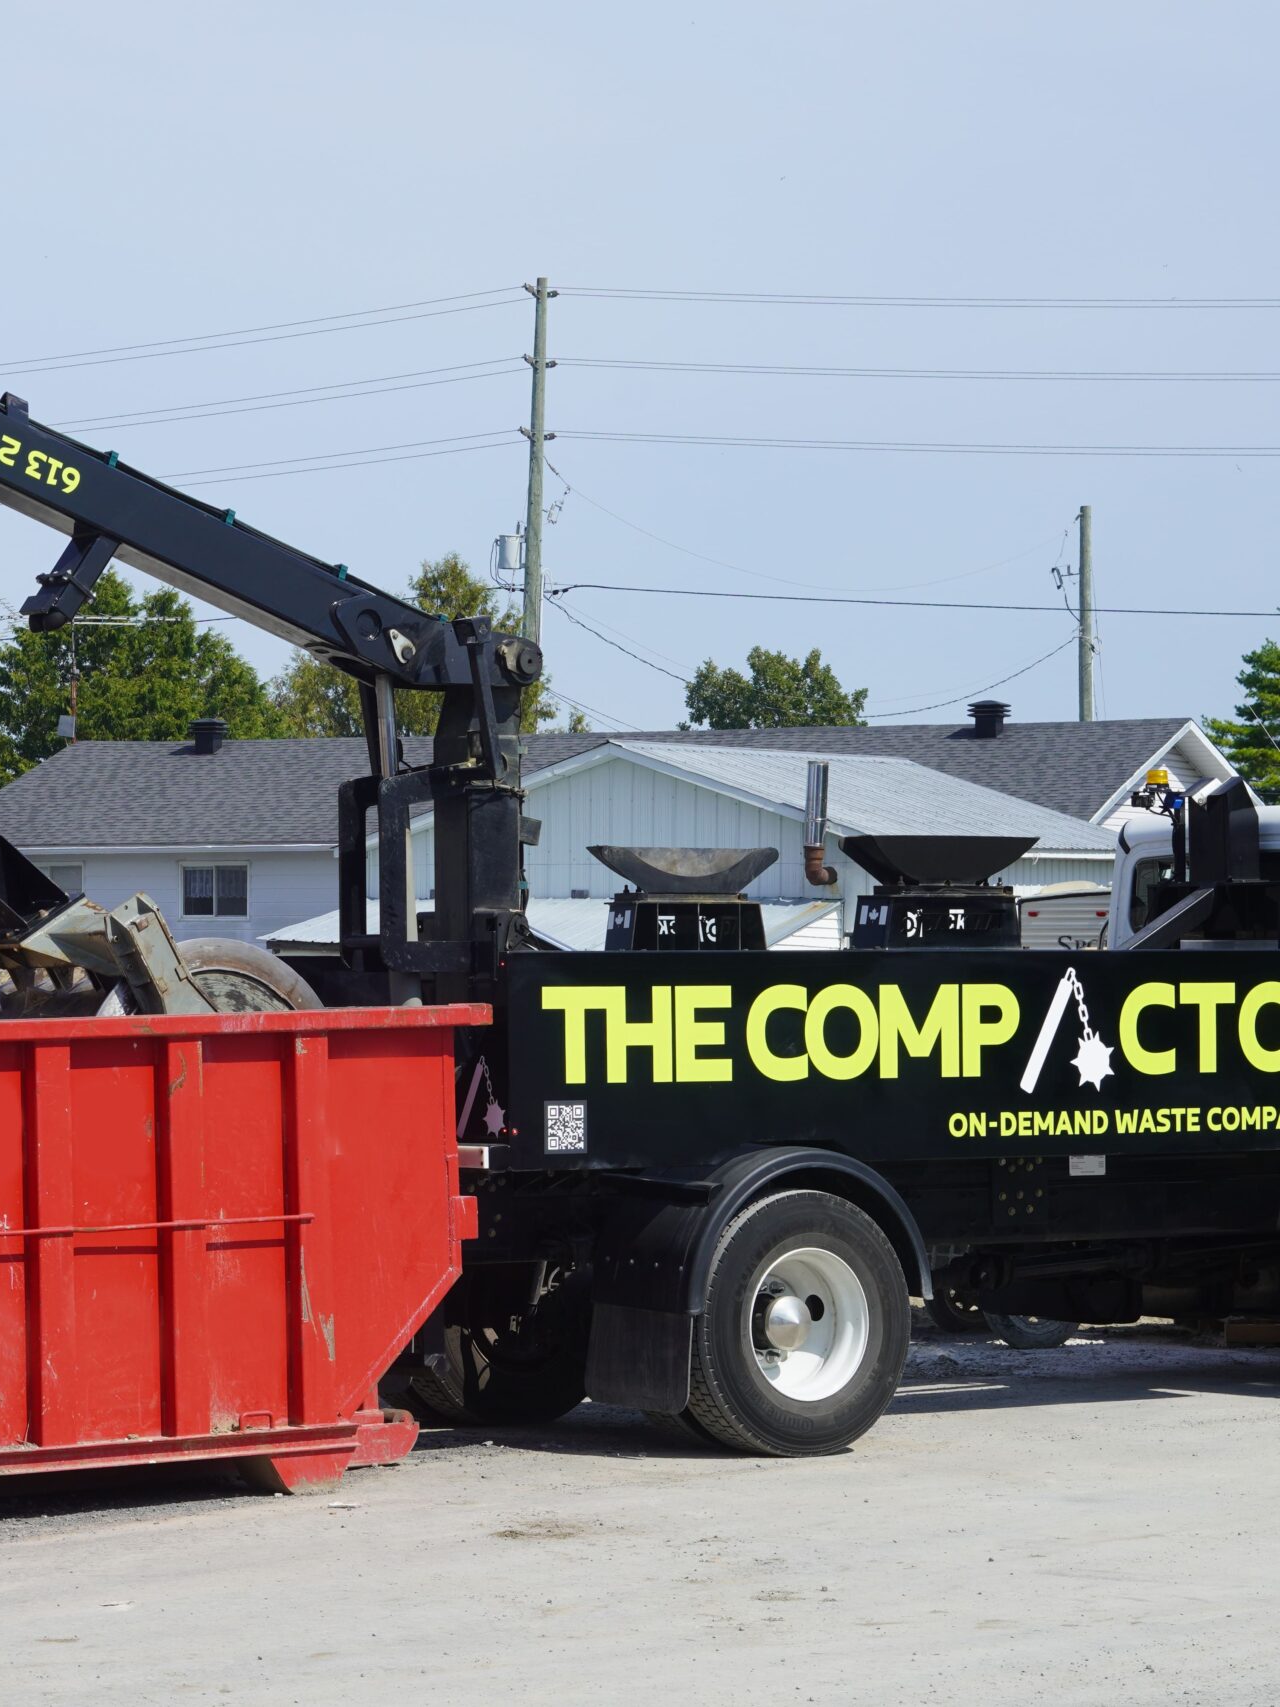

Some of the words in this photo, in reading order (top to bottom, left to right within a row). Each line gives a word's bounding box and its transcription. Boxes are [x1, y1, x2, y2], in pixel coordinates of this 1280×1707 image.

[26, 451, 80, 494] 613
[542, 984, 733, 1085] THE
[949, 1109, 1109, 1138] ON-DEMAND
[1115, 1107, 1201, 1134] WASTE
[1207, 1105, 1280, 1132] COMP
